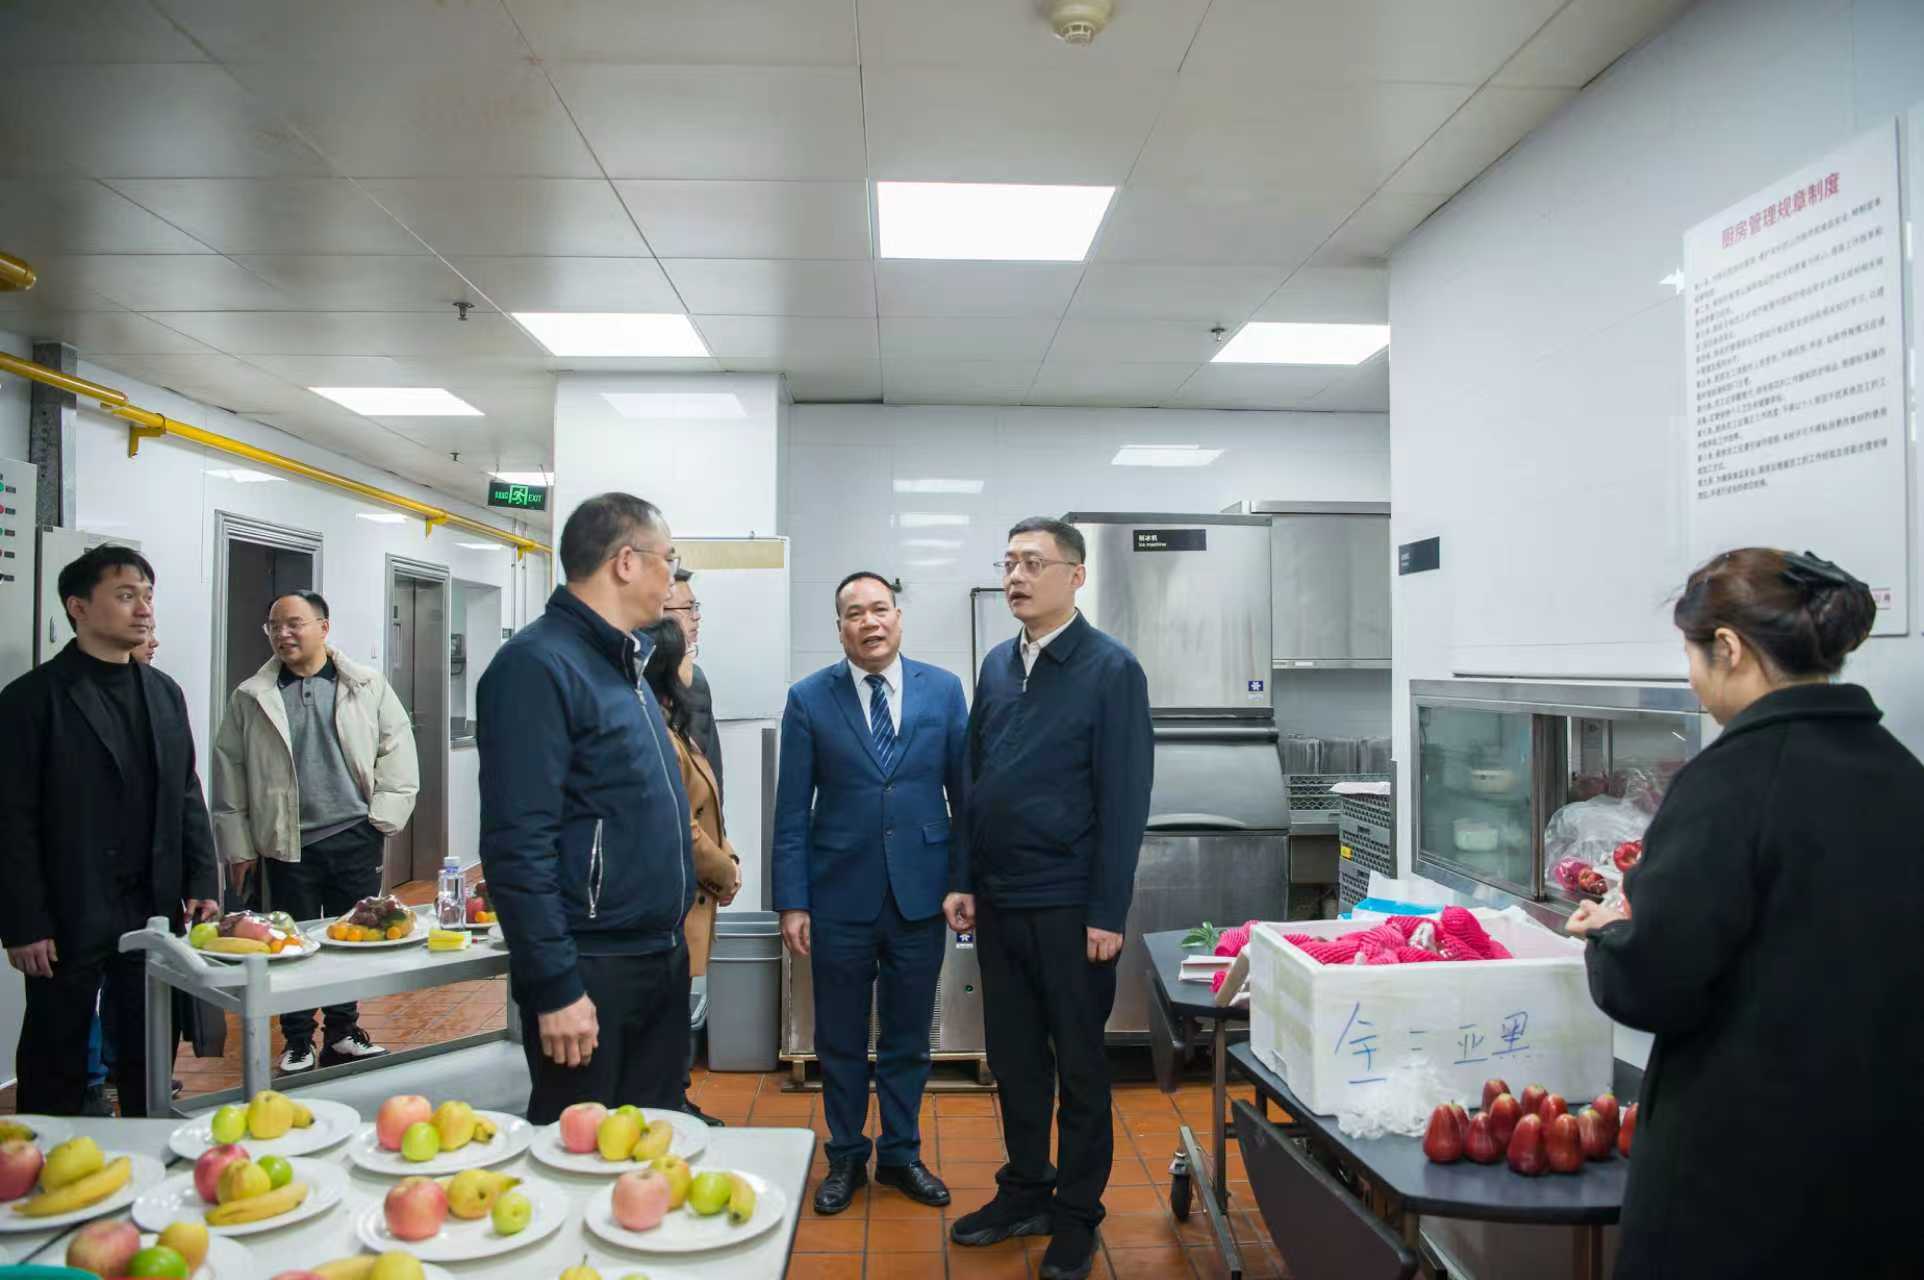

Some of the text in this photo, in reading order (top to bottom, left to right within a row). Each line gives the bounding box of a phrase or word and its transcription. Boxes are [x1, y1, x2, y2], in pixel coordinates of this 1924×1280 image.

[1721, 172, 1840, 249] 厨房管理规章制度
